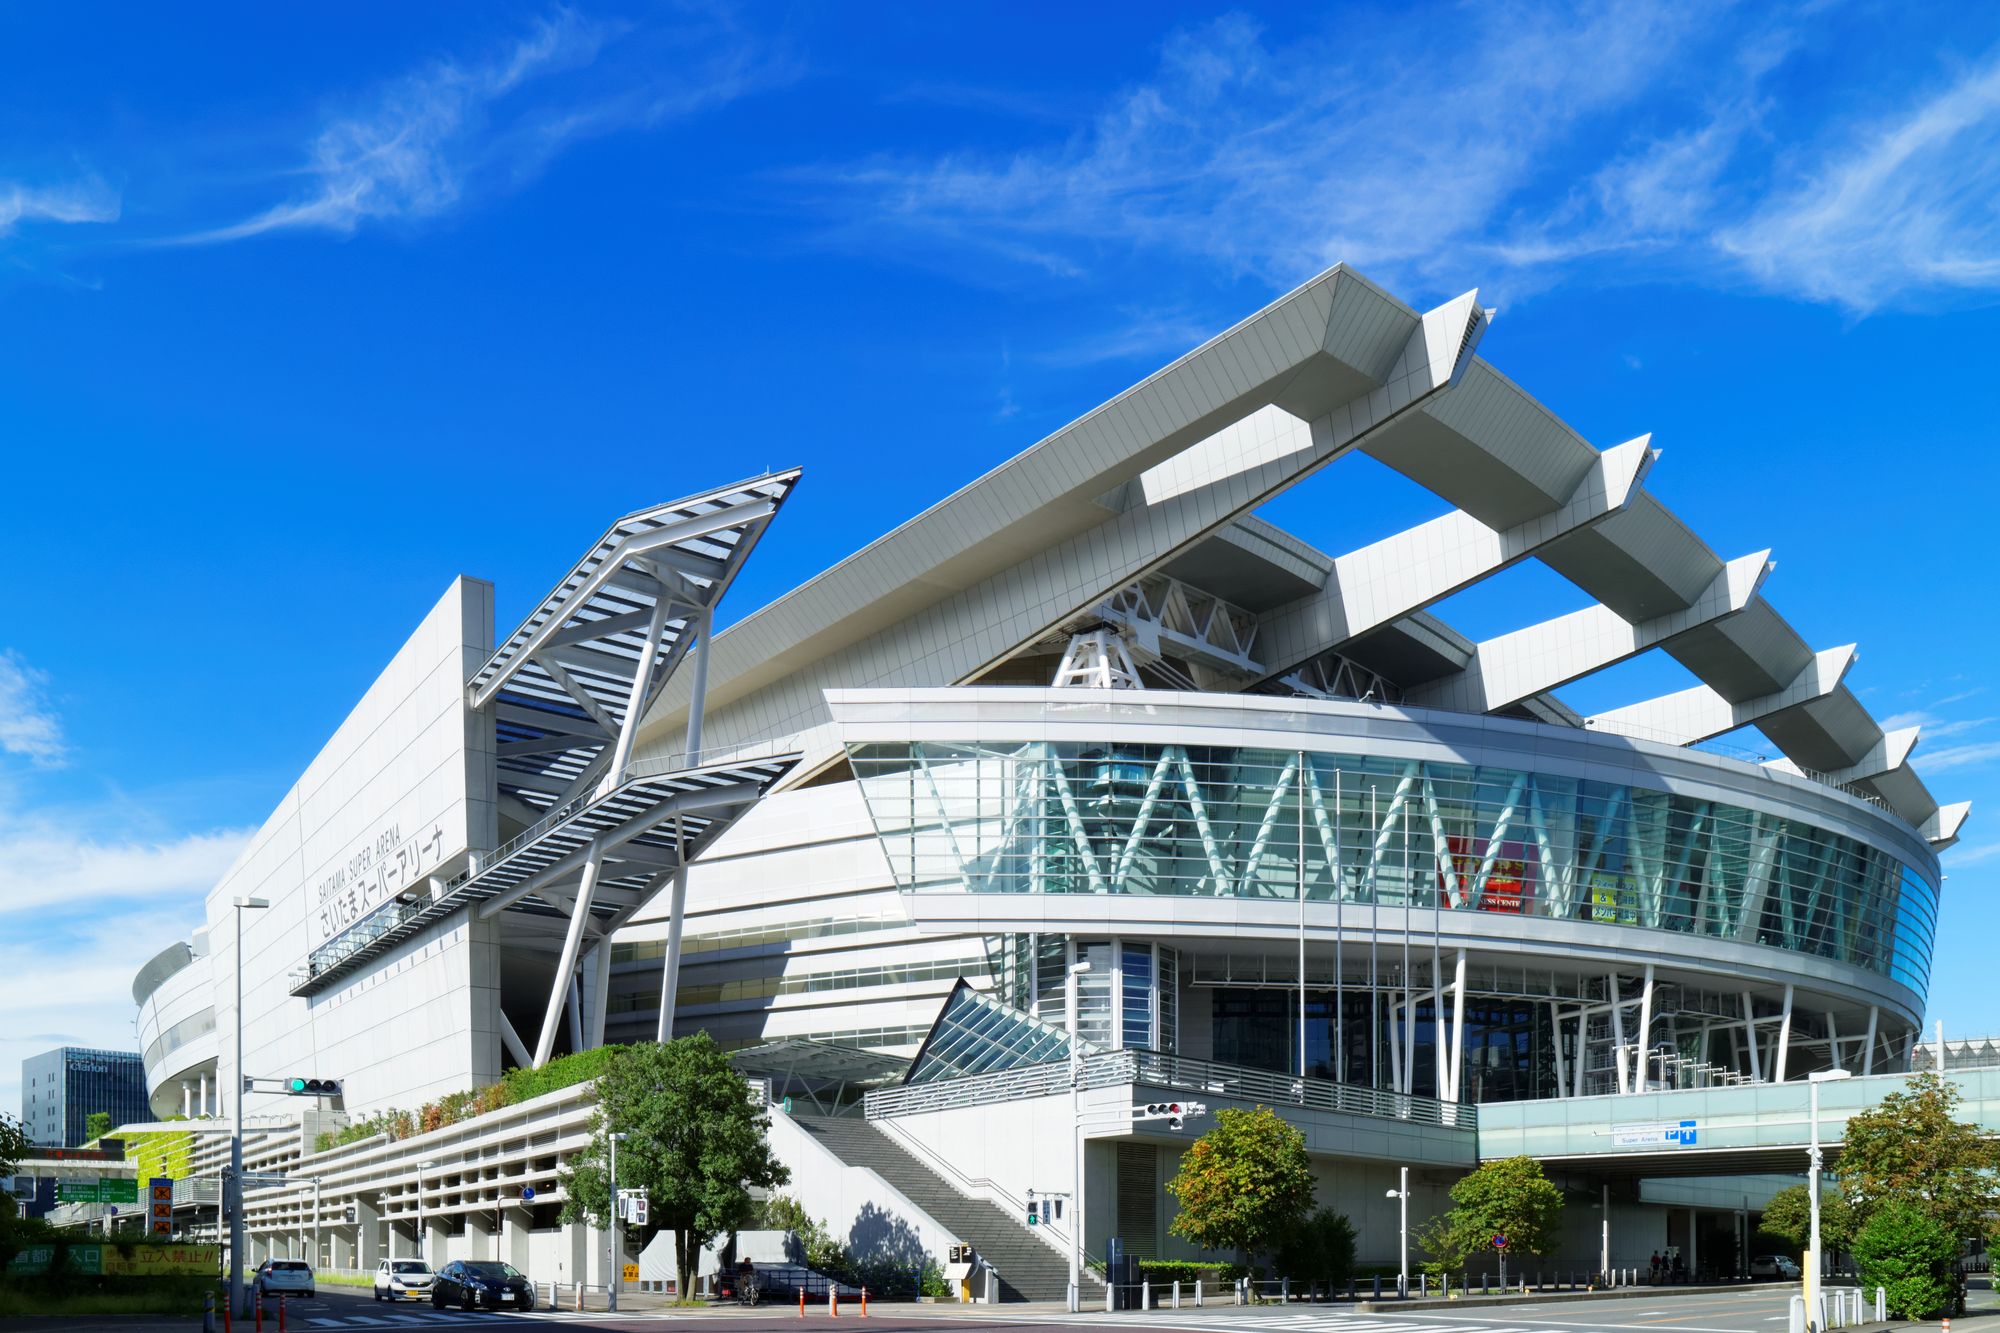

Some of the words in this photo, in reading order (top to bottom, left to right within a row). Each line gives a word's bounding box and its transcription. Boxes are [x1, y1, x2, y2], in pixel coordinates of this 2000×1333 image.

[318, 867, 346, 904] SAITAMA
[348, 846, 372, 881] SUPER
[375, 822, 401, 861] ARENA
[320, 824, 443, 938] さいたまスーパーアリーナ
